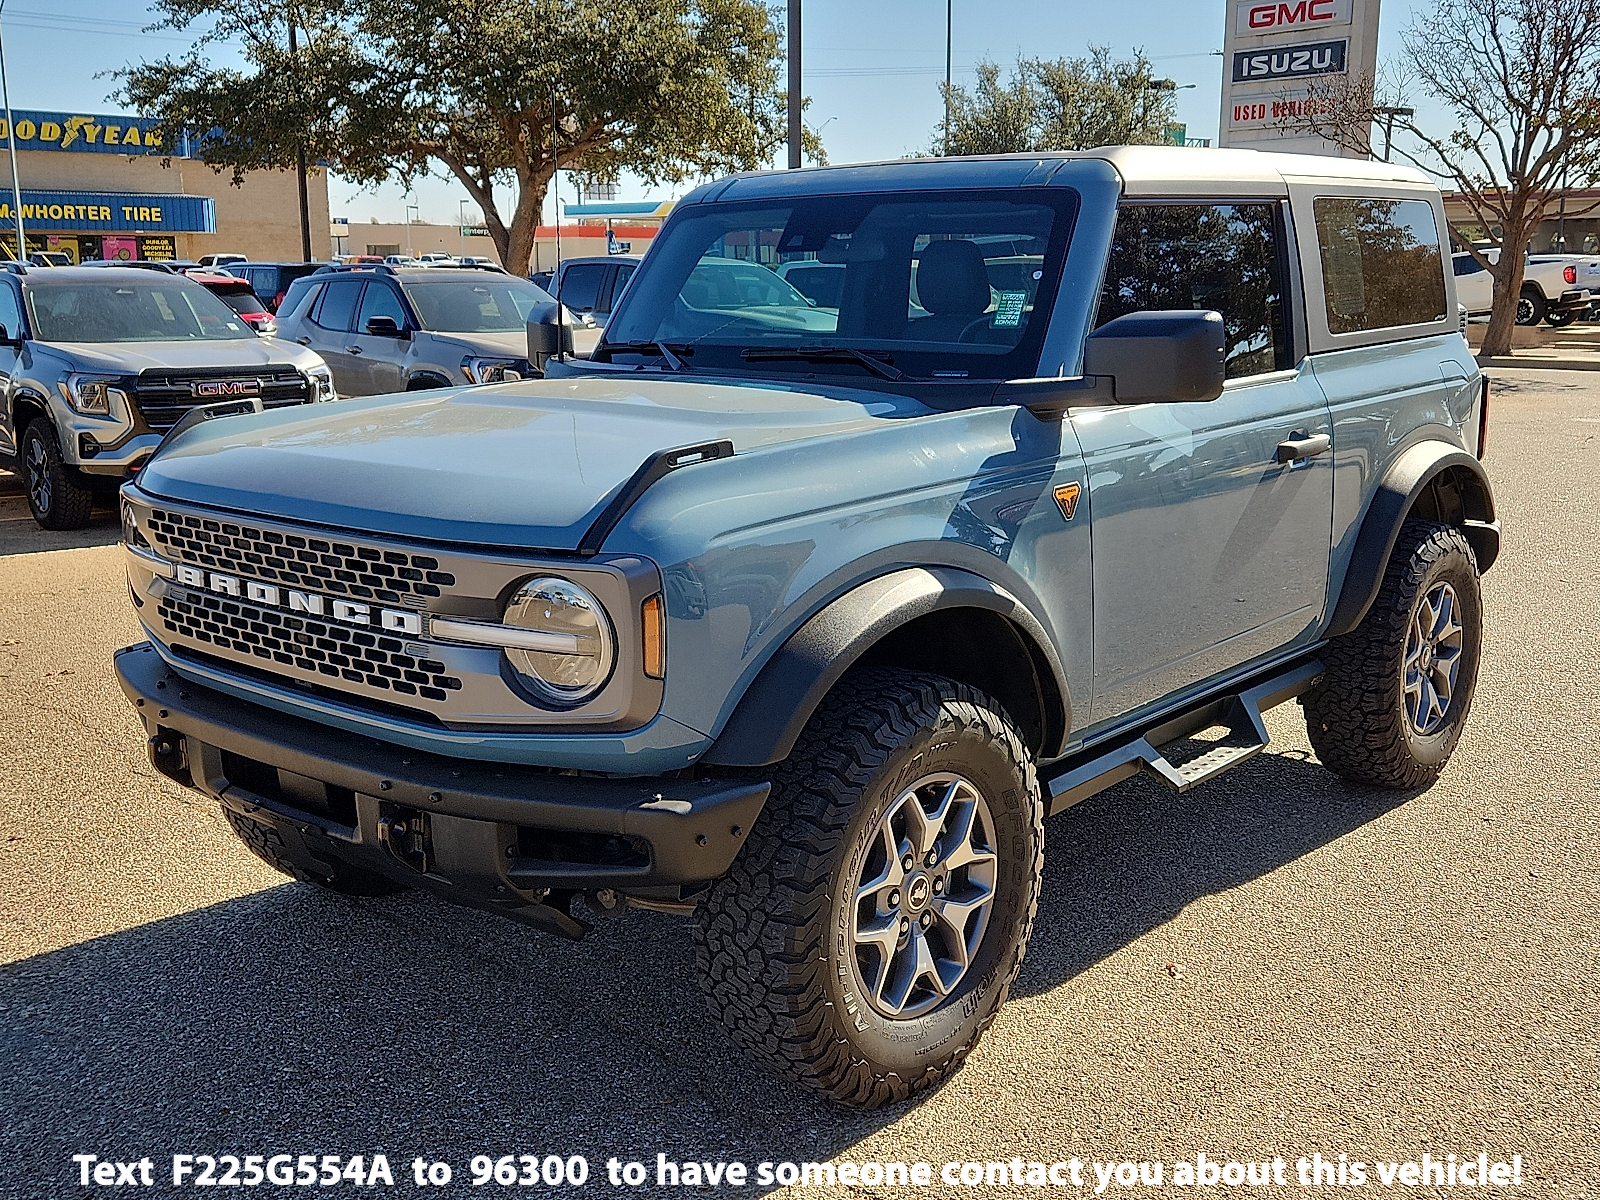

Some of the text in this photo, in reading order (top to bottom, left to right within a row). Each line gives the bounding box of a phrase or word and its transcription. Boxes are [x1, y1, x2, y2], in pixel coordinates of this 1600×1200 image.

[1249, 0, 1334, 28] GMC
[1242, 48, 1332, 77] ISUZU
[1234, 98, 1335, 121] USED VEHICLE
[122, 206, 162, 222] TIRE
[198, 382, 259, 396] GMC
[176, 564, 422, 635] BRONCO
